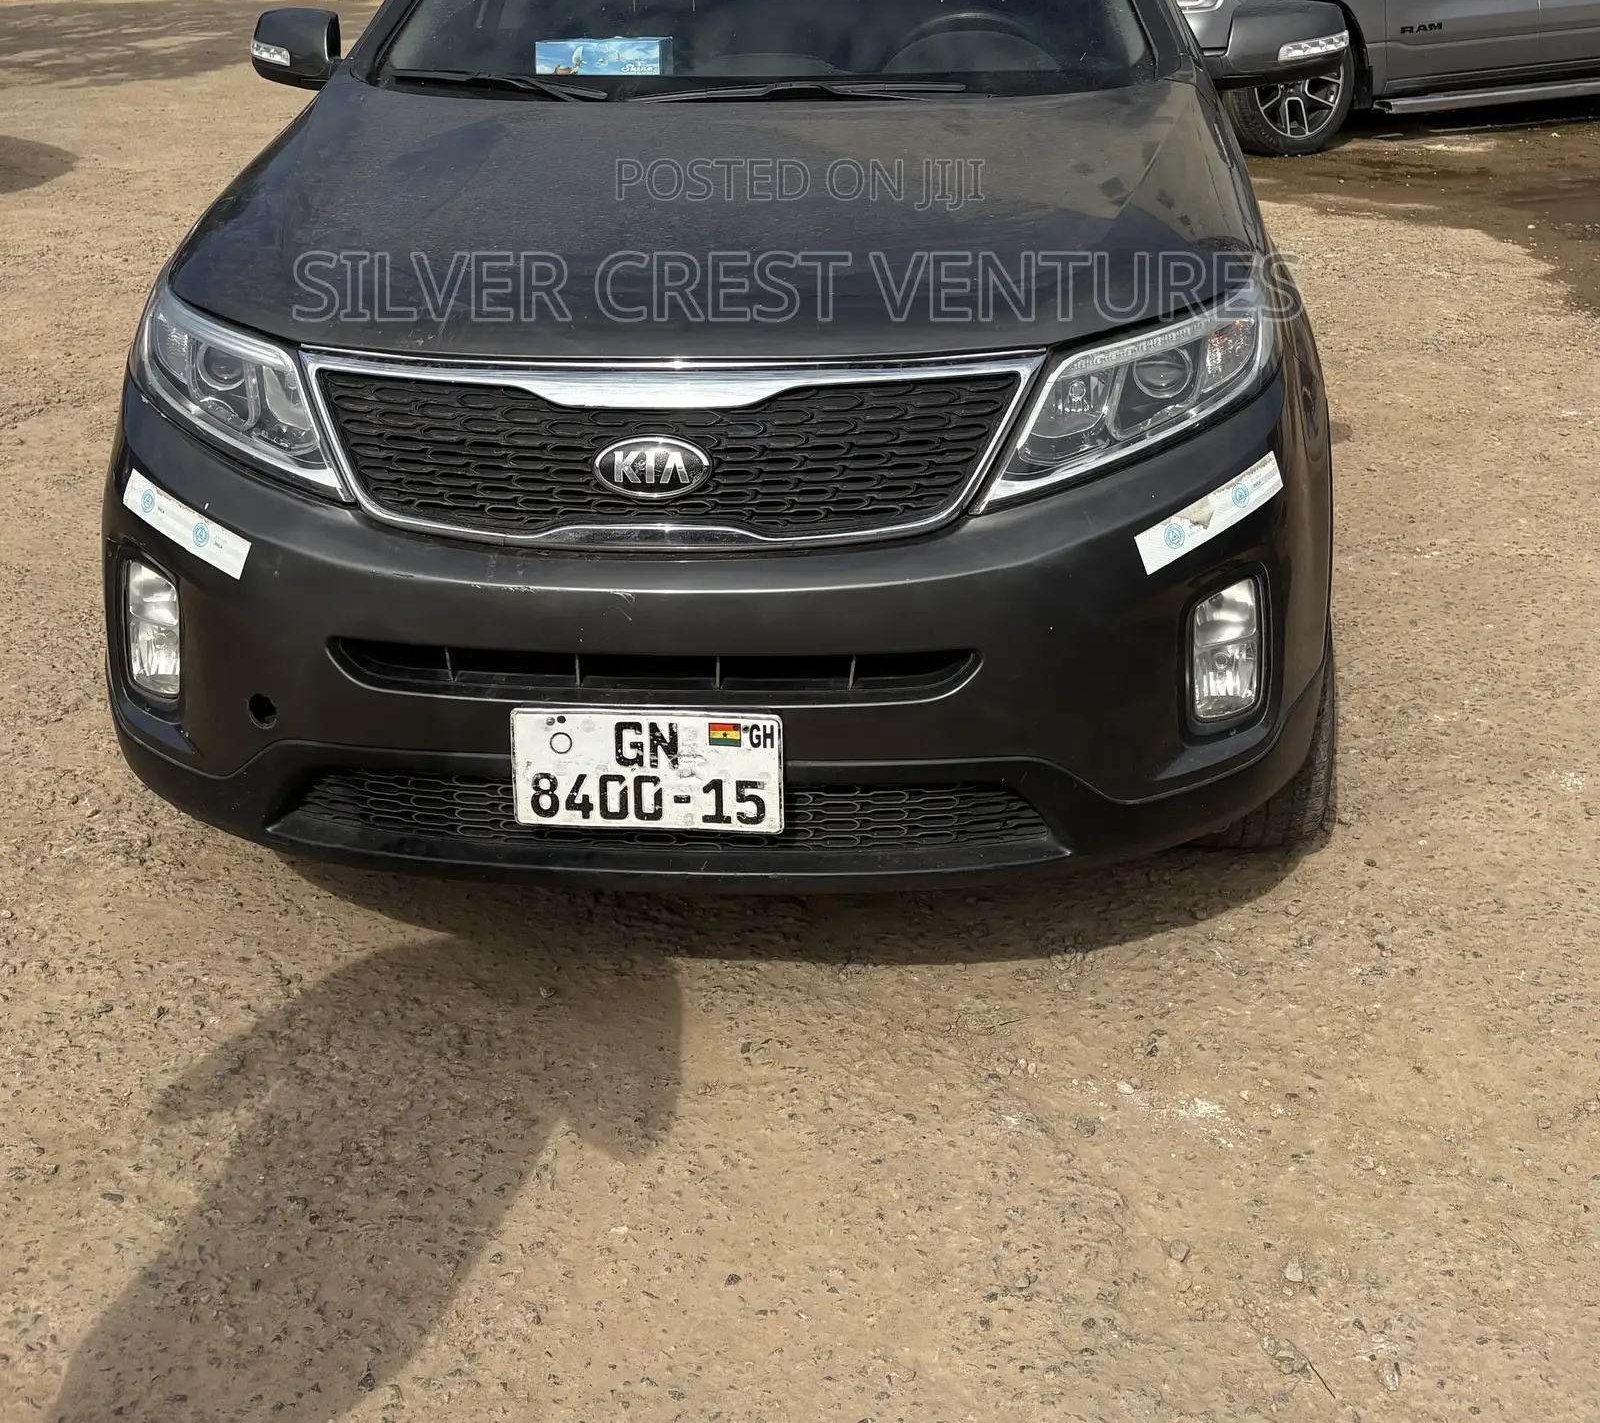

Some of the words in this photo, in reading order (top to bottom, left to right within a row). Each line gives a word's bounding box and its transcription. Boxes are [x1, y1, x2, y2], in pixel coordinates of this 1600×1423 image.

[1400, 22, 1443, 34] RAM
[613, 450, 691, 484] KIA
[614, 721, 679, 770] GN
[749, 724, 775, 749] GH
[530, 772, 766, 826] 8400-15
